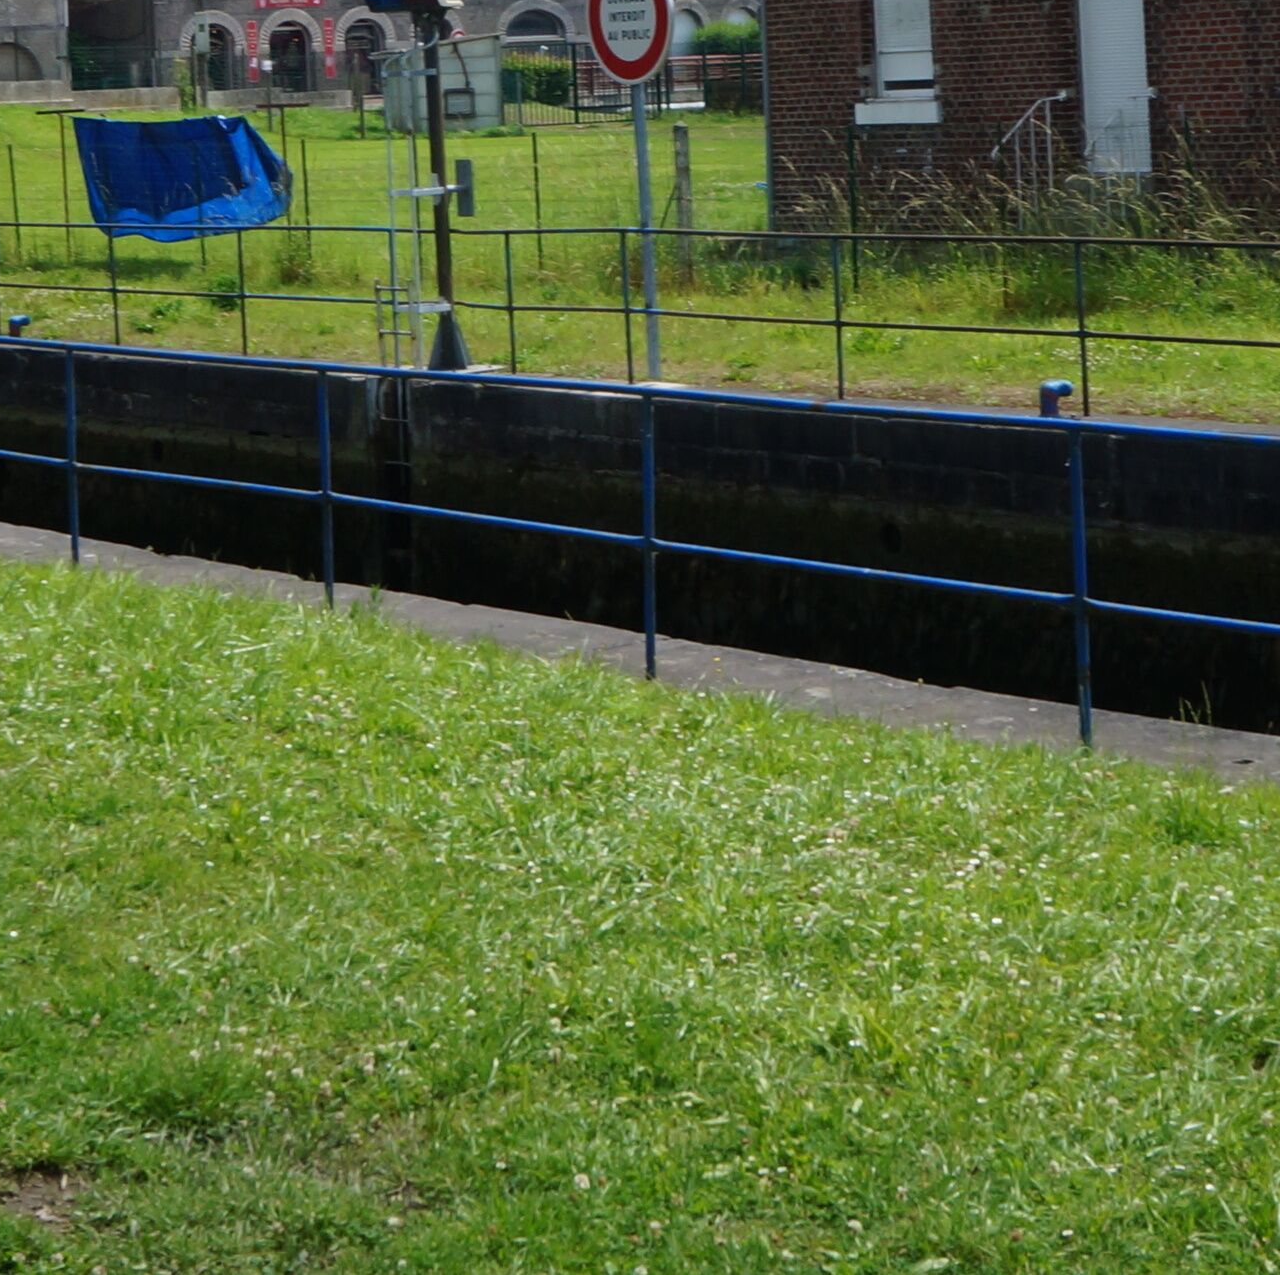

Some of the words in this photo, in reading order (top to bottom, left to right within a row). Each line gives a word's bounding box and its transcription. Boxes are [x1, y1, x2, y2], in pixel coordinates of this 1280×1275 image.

[609, 10, 646, 22] INTERDIT
[608, 30, 619, 41] AU
[621, 29, 650, 41] PUBLIC
